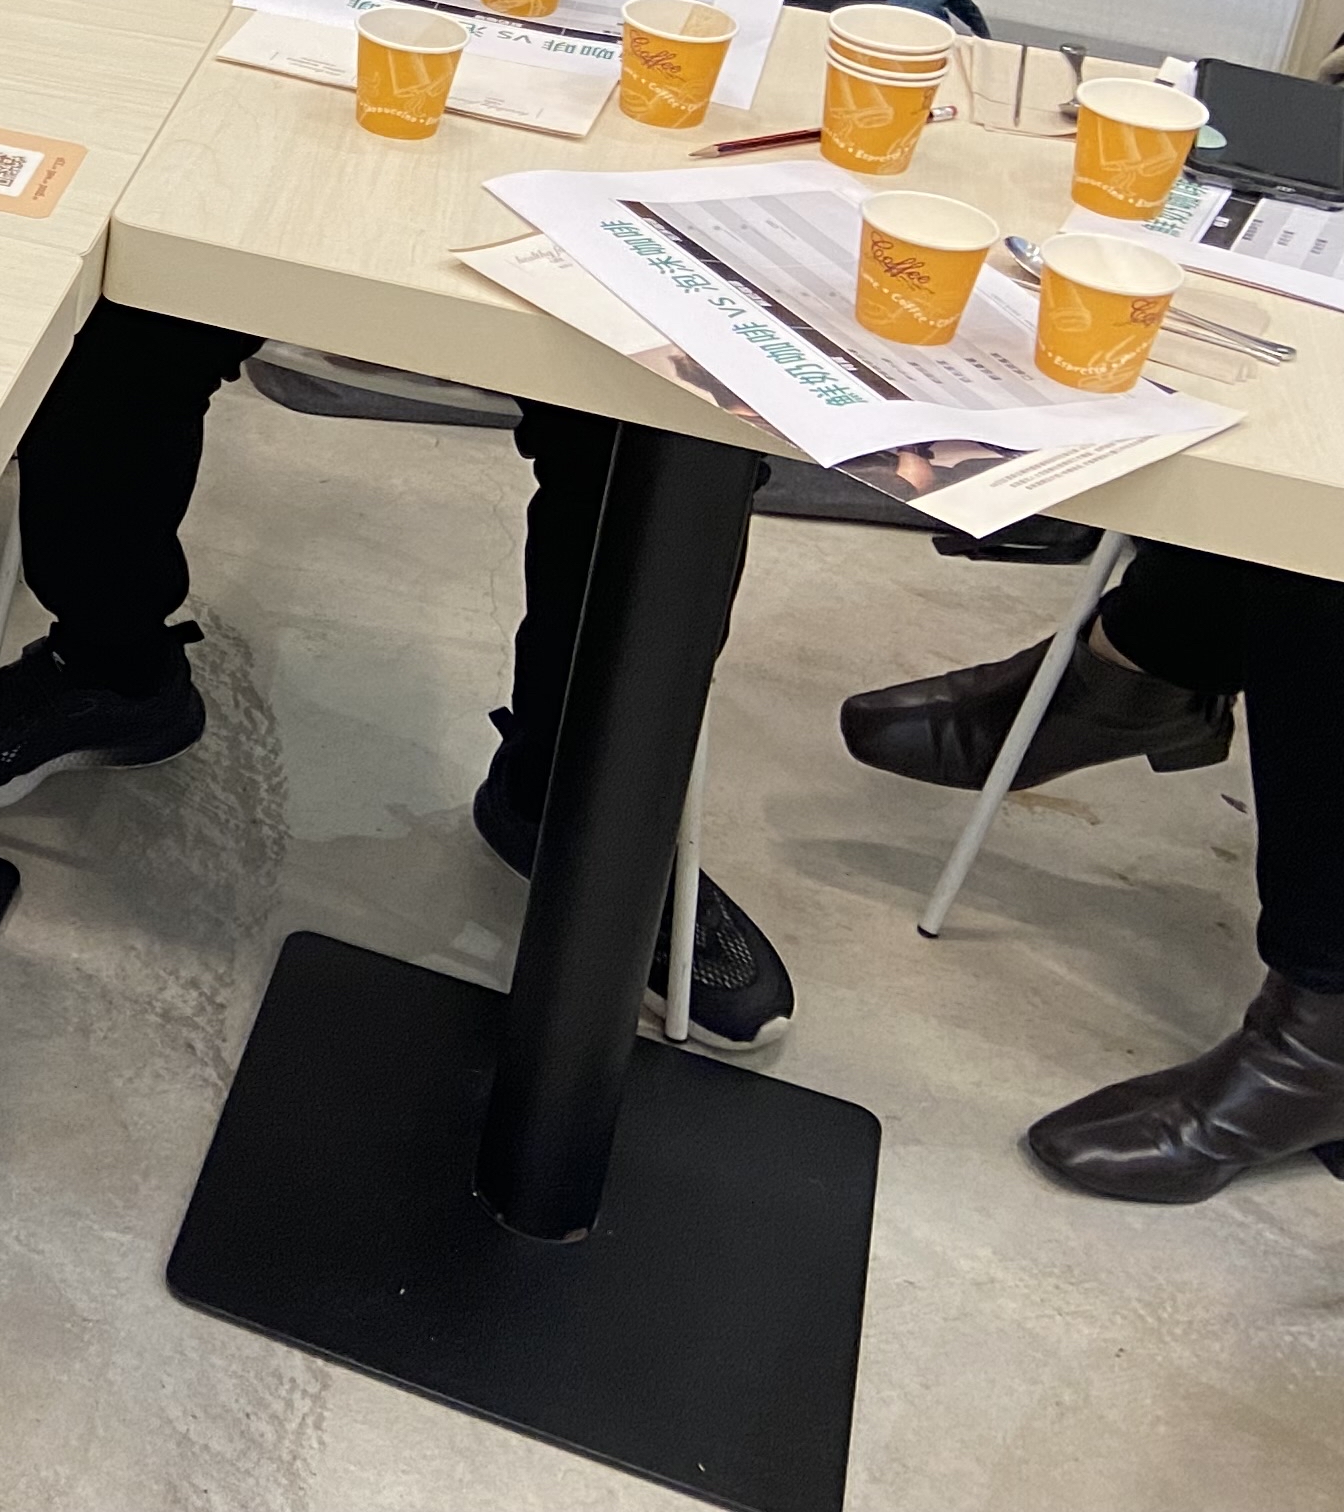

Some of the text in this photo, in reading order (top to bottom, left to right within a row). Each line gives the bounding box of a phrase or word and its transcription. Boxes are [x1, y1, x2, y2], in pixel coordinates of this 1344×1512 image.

[496, 29, 533, 45] VS
[541, 38, 623, 61] 咖啡
[629, 31, 682, 76] Coffee
[648, 81, 682, 110] Coffee
[599, 219, 718, 294] 泡沫咖啡
[870, 229, 932, 286] Coffee
[708, 296, 747, 319] VS
[891, 291, 927, 324] Coffee
[733, 321, 869, 407] 鮮奶咖啡
